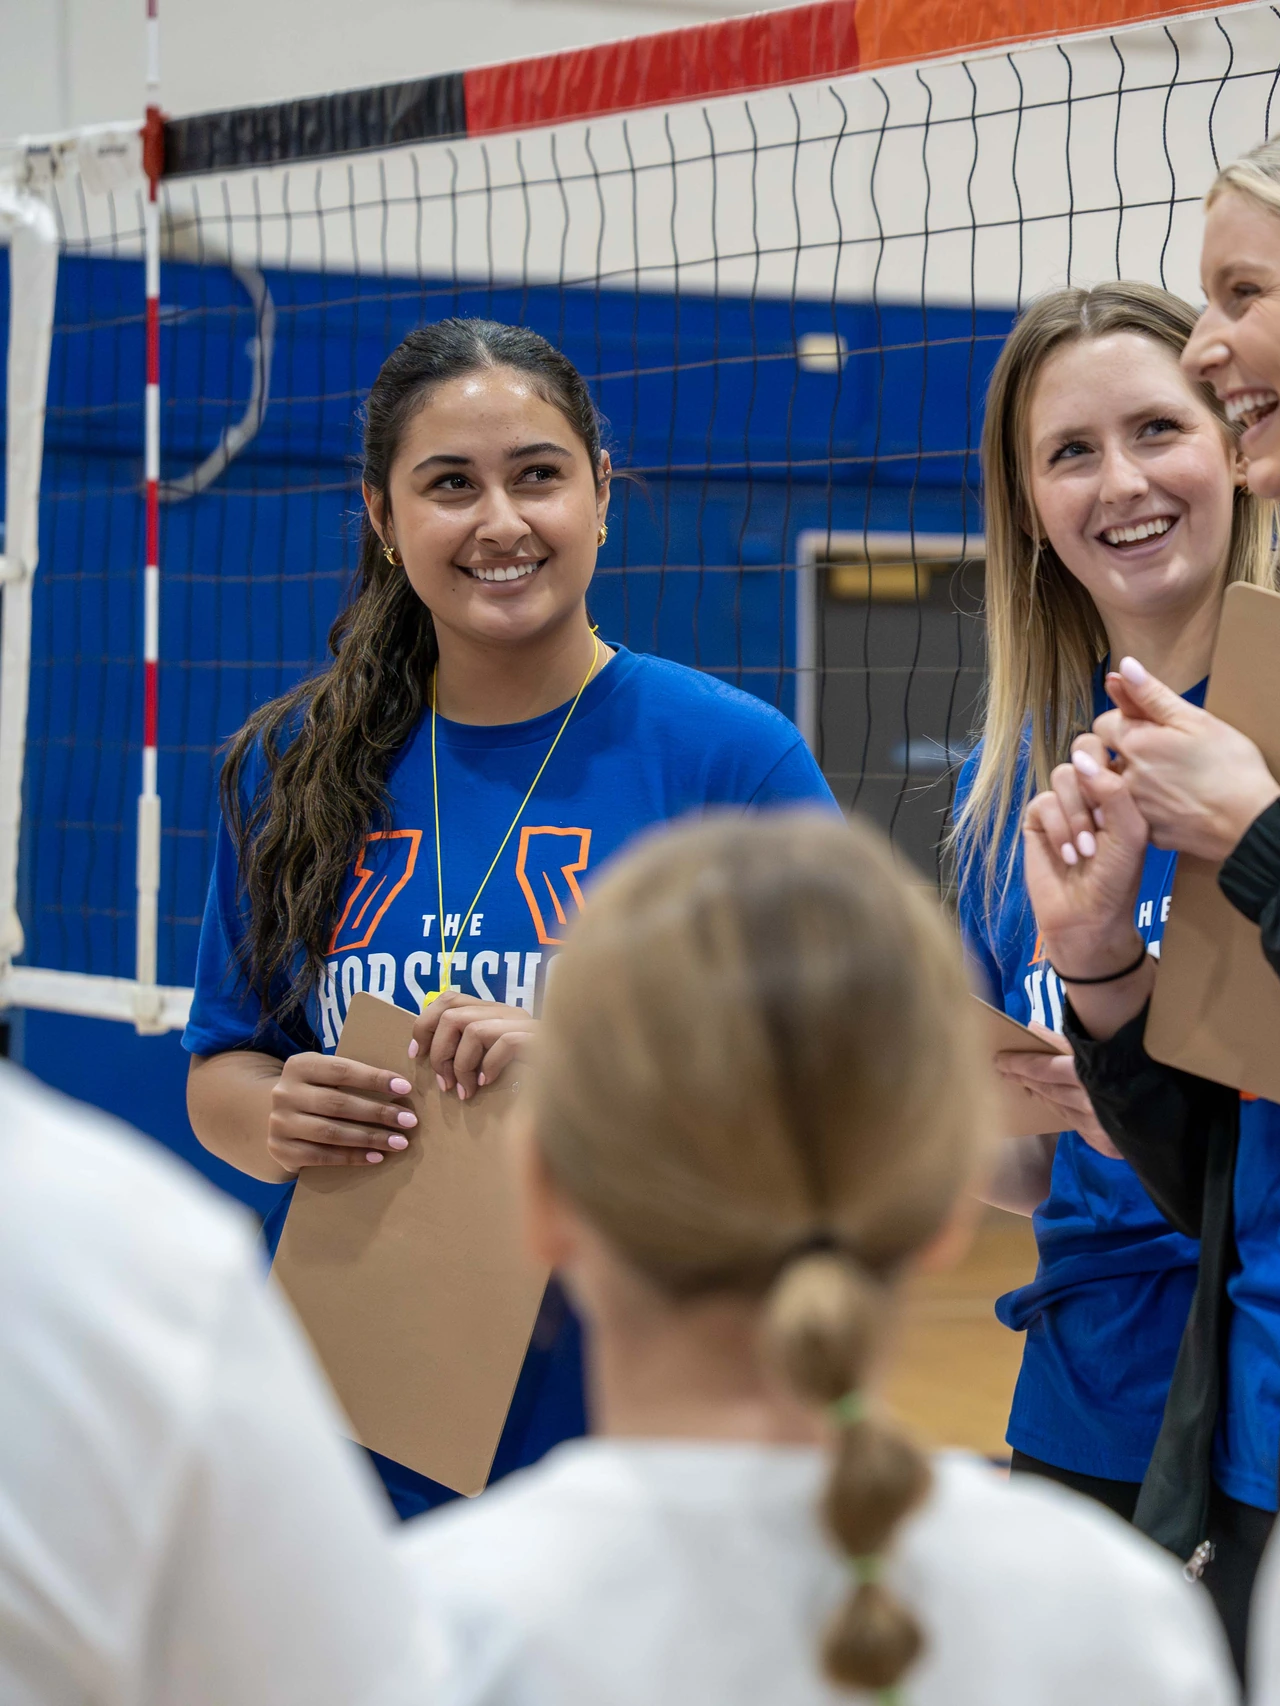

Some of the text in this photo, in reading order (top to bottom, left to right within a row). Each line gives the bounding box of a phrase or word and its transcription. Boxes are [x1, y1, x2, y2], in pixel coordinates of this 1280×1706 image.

[422, 913, 484, 937] THE
[1138, 895, 1172, 928] HE
[317, 950, 560, 1049] HORSSH
